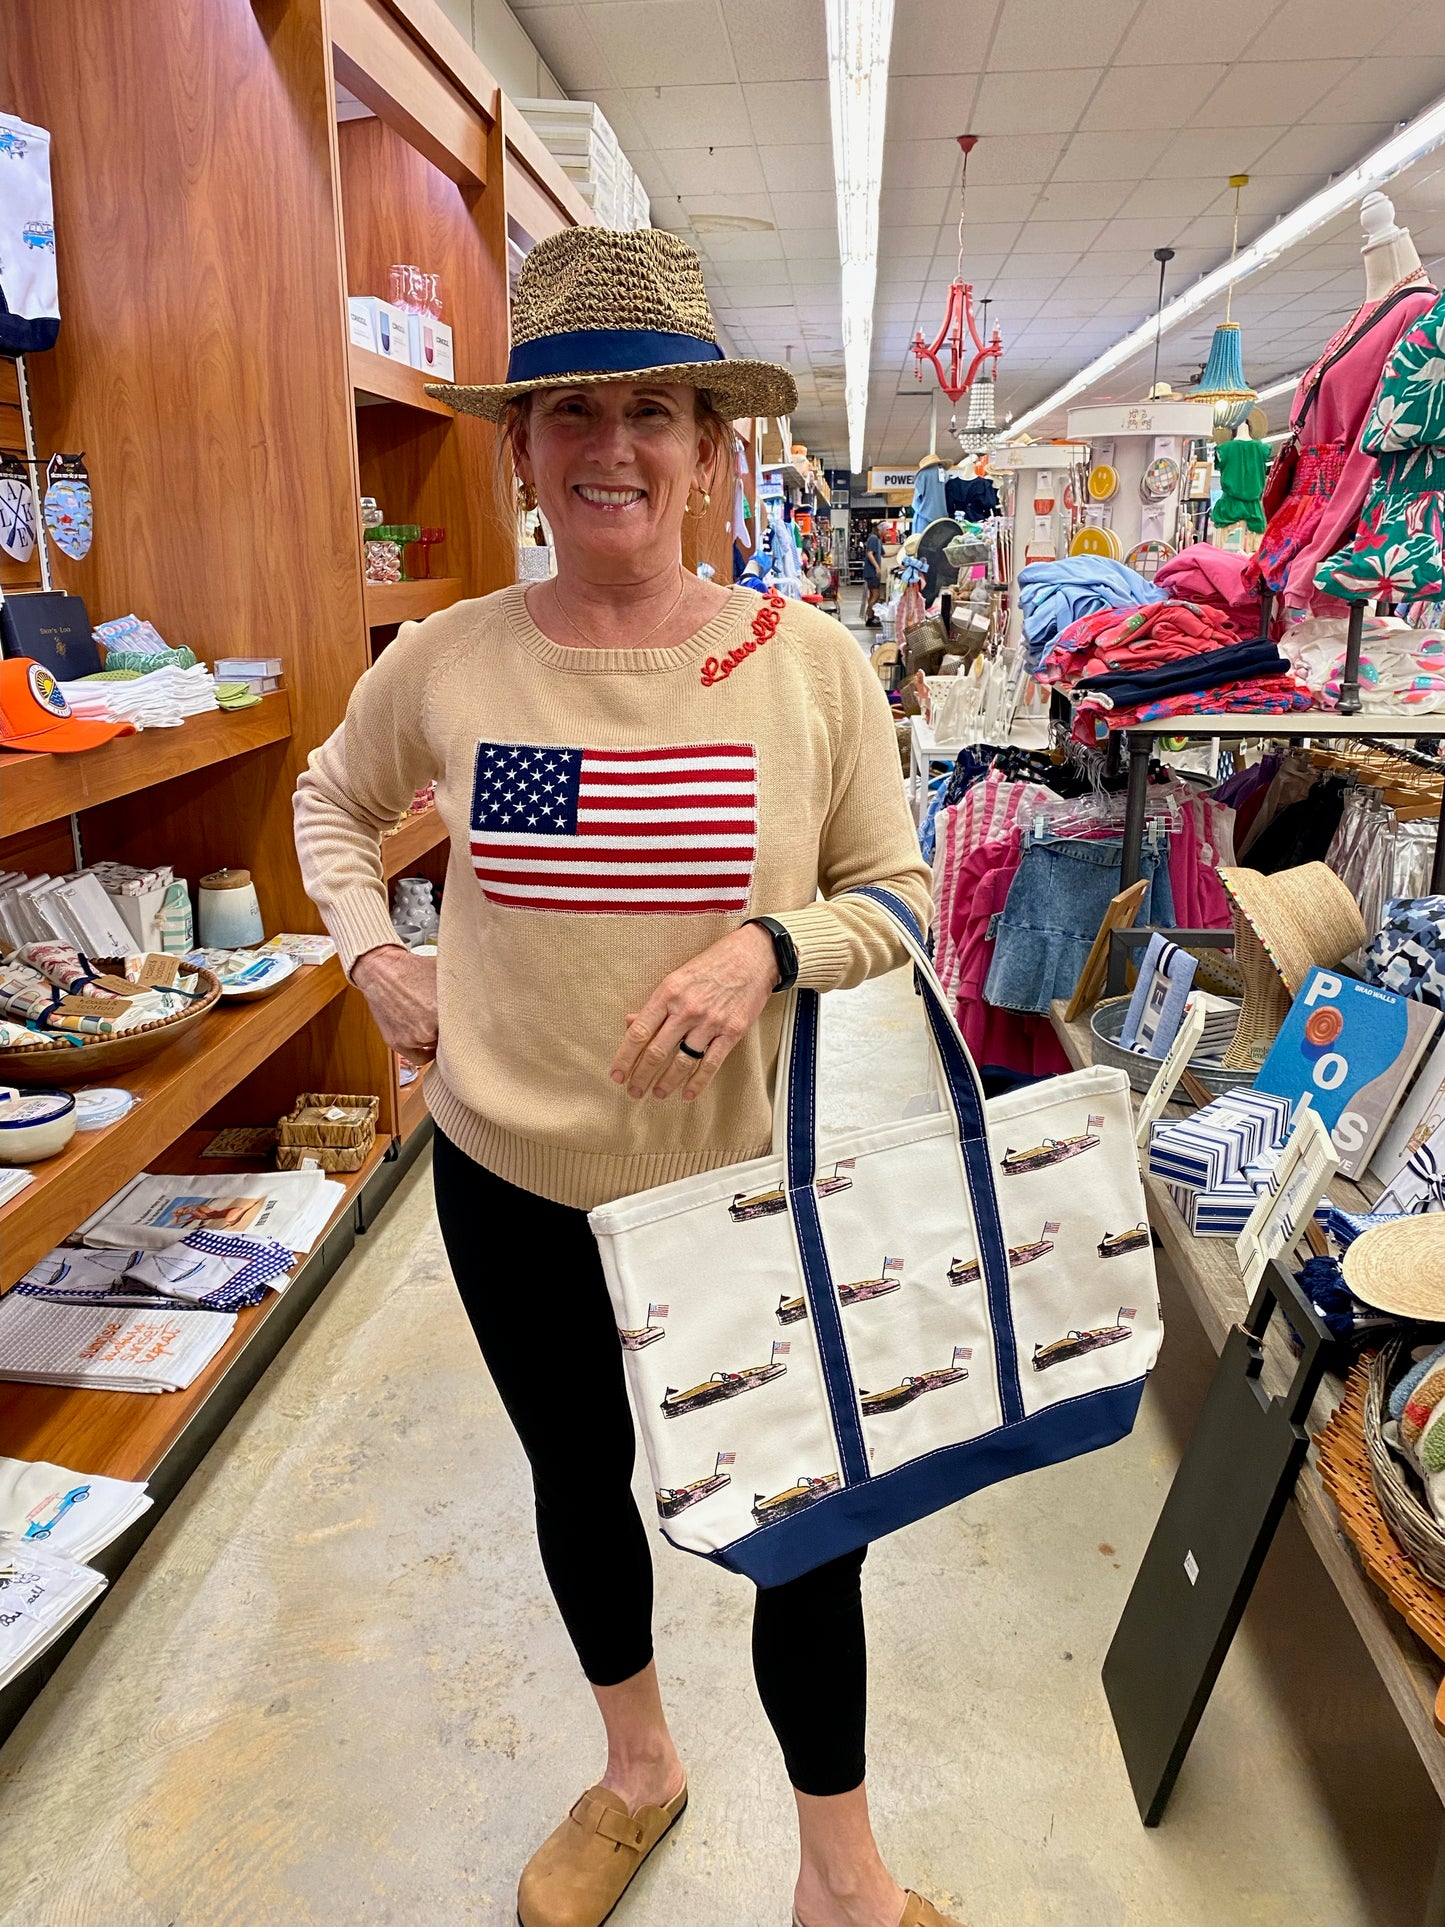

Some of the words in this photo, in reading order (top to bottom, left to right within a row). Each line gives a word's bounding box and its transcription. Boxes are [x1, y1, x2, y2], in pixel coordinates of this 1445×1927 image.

[884, 474, 915, 485] POWE
[1354, 984, 1373, 997] BRAD
[1372, 991, 1397, 1005] WALLS
